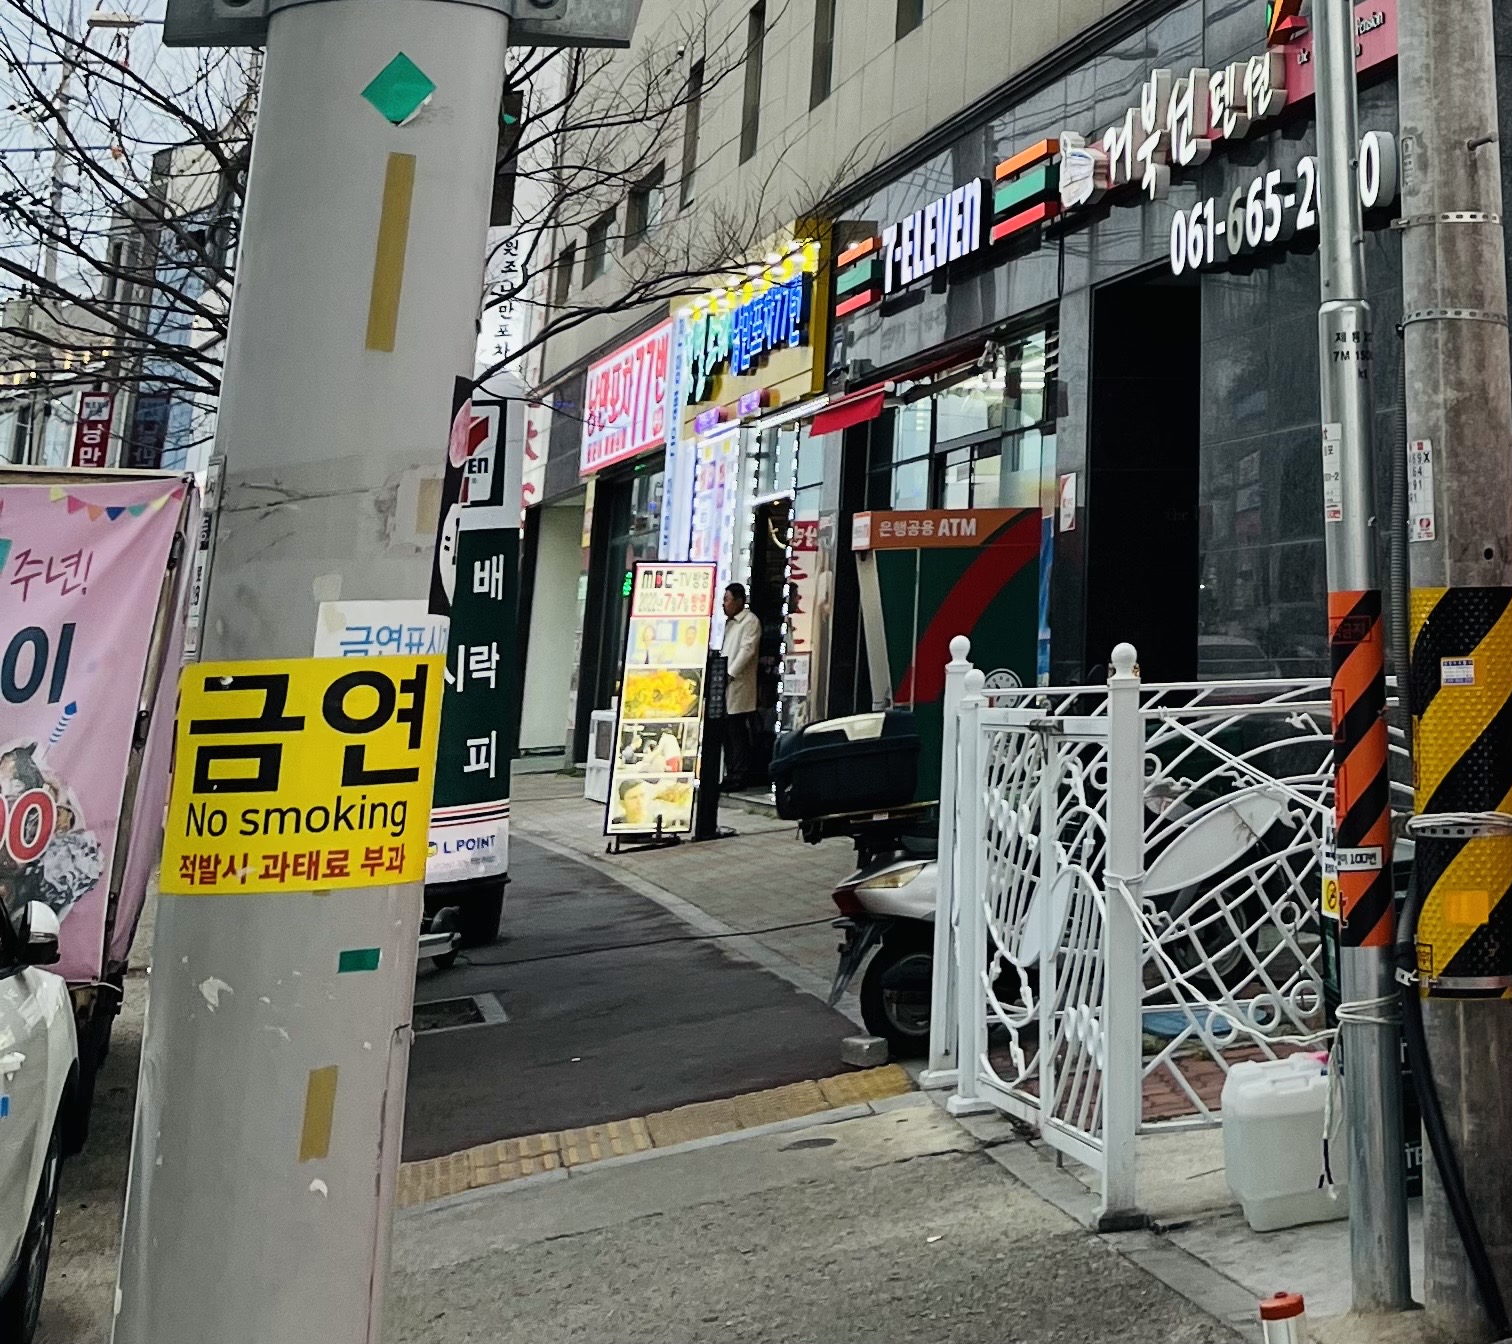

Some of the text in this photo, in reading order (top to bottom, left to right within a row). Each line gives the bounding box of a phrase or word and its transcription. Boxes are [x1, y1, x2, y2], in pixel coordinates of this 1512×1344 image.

[1170, 130, 1382, 276] 061-665-20
[878, 519, 935, 538] 은행공용
[937, 517, 977, 537] ATM
[189, 664, 429, 794] 금연
[185, 795, 407, 837] No smoking
[179, 843, 406, 886] 적발시 과태료 부과
